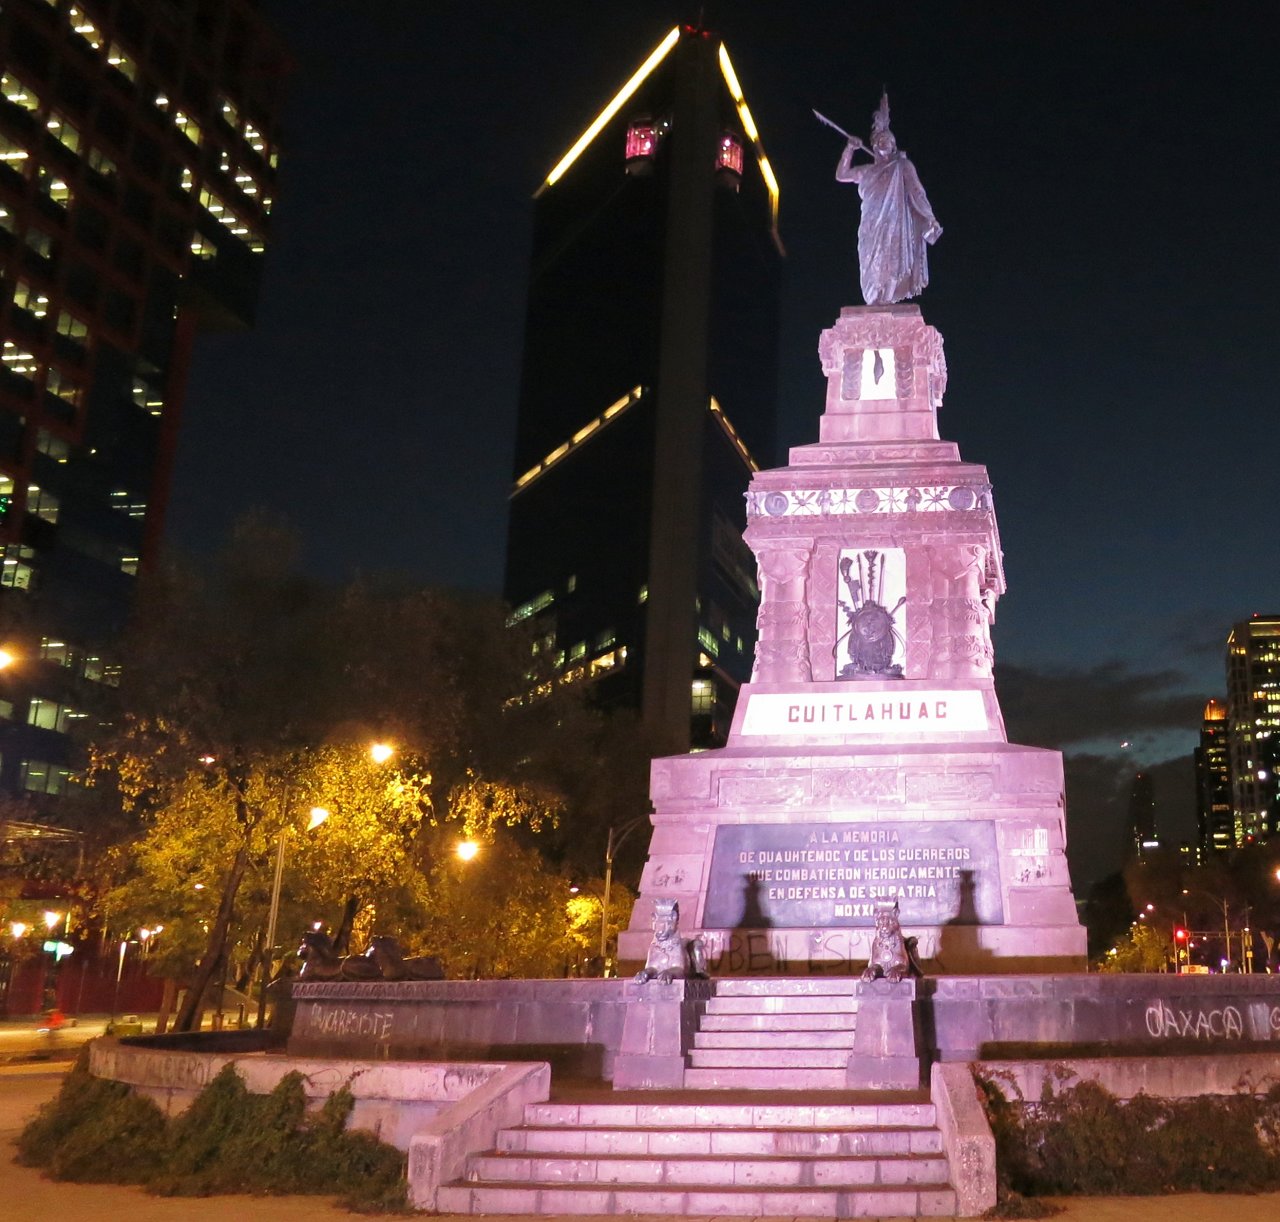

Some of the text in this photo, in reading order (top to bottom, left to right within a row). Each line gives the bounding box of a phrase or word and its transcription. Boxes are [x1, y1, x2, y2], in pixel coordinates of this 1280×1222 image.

[788, 701, 947, 723] CUITLAHUAC
[810, 830, 899, 843] A LA MEMORIA
[739, 848, 970, 864] DE QUAUHTEMOC Y DE LOS GUERREROS
[750, 867, 961, 881] QUE COMBATIERON HEROICAMENTE
[768, 885, 936, 900] EN DEFENSA DE SU PATRIA
[1145, 999, 1243, 1042] OAXACA
